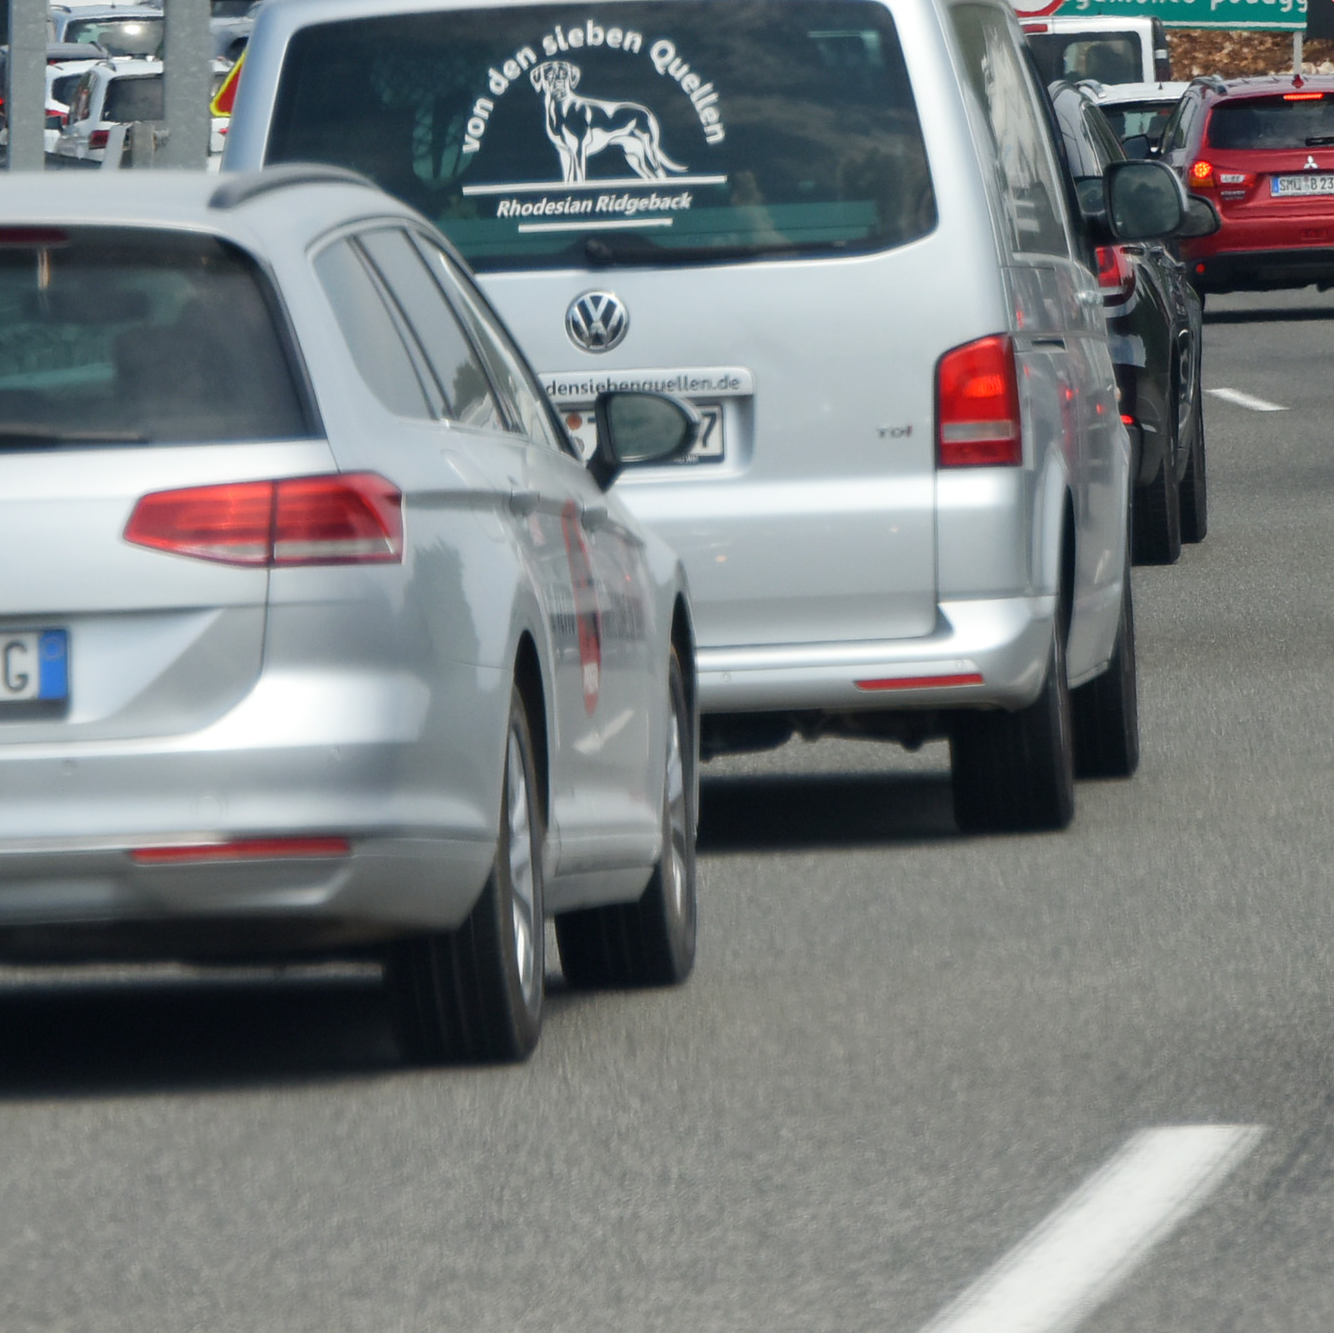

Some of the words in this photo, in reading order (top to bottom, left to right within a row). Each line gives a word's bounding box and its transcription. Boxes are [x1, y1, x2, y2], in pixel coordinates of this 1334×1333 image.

[462, 97, 495, 154] von
[488, 47, 537, 96] den
[542, 19, 643, 56] sieben
[650, 39, 726, 146] Quellen
[497, 196, 592, 217] Rhodesian
[595, 191, 693, 214] Ridgeback
